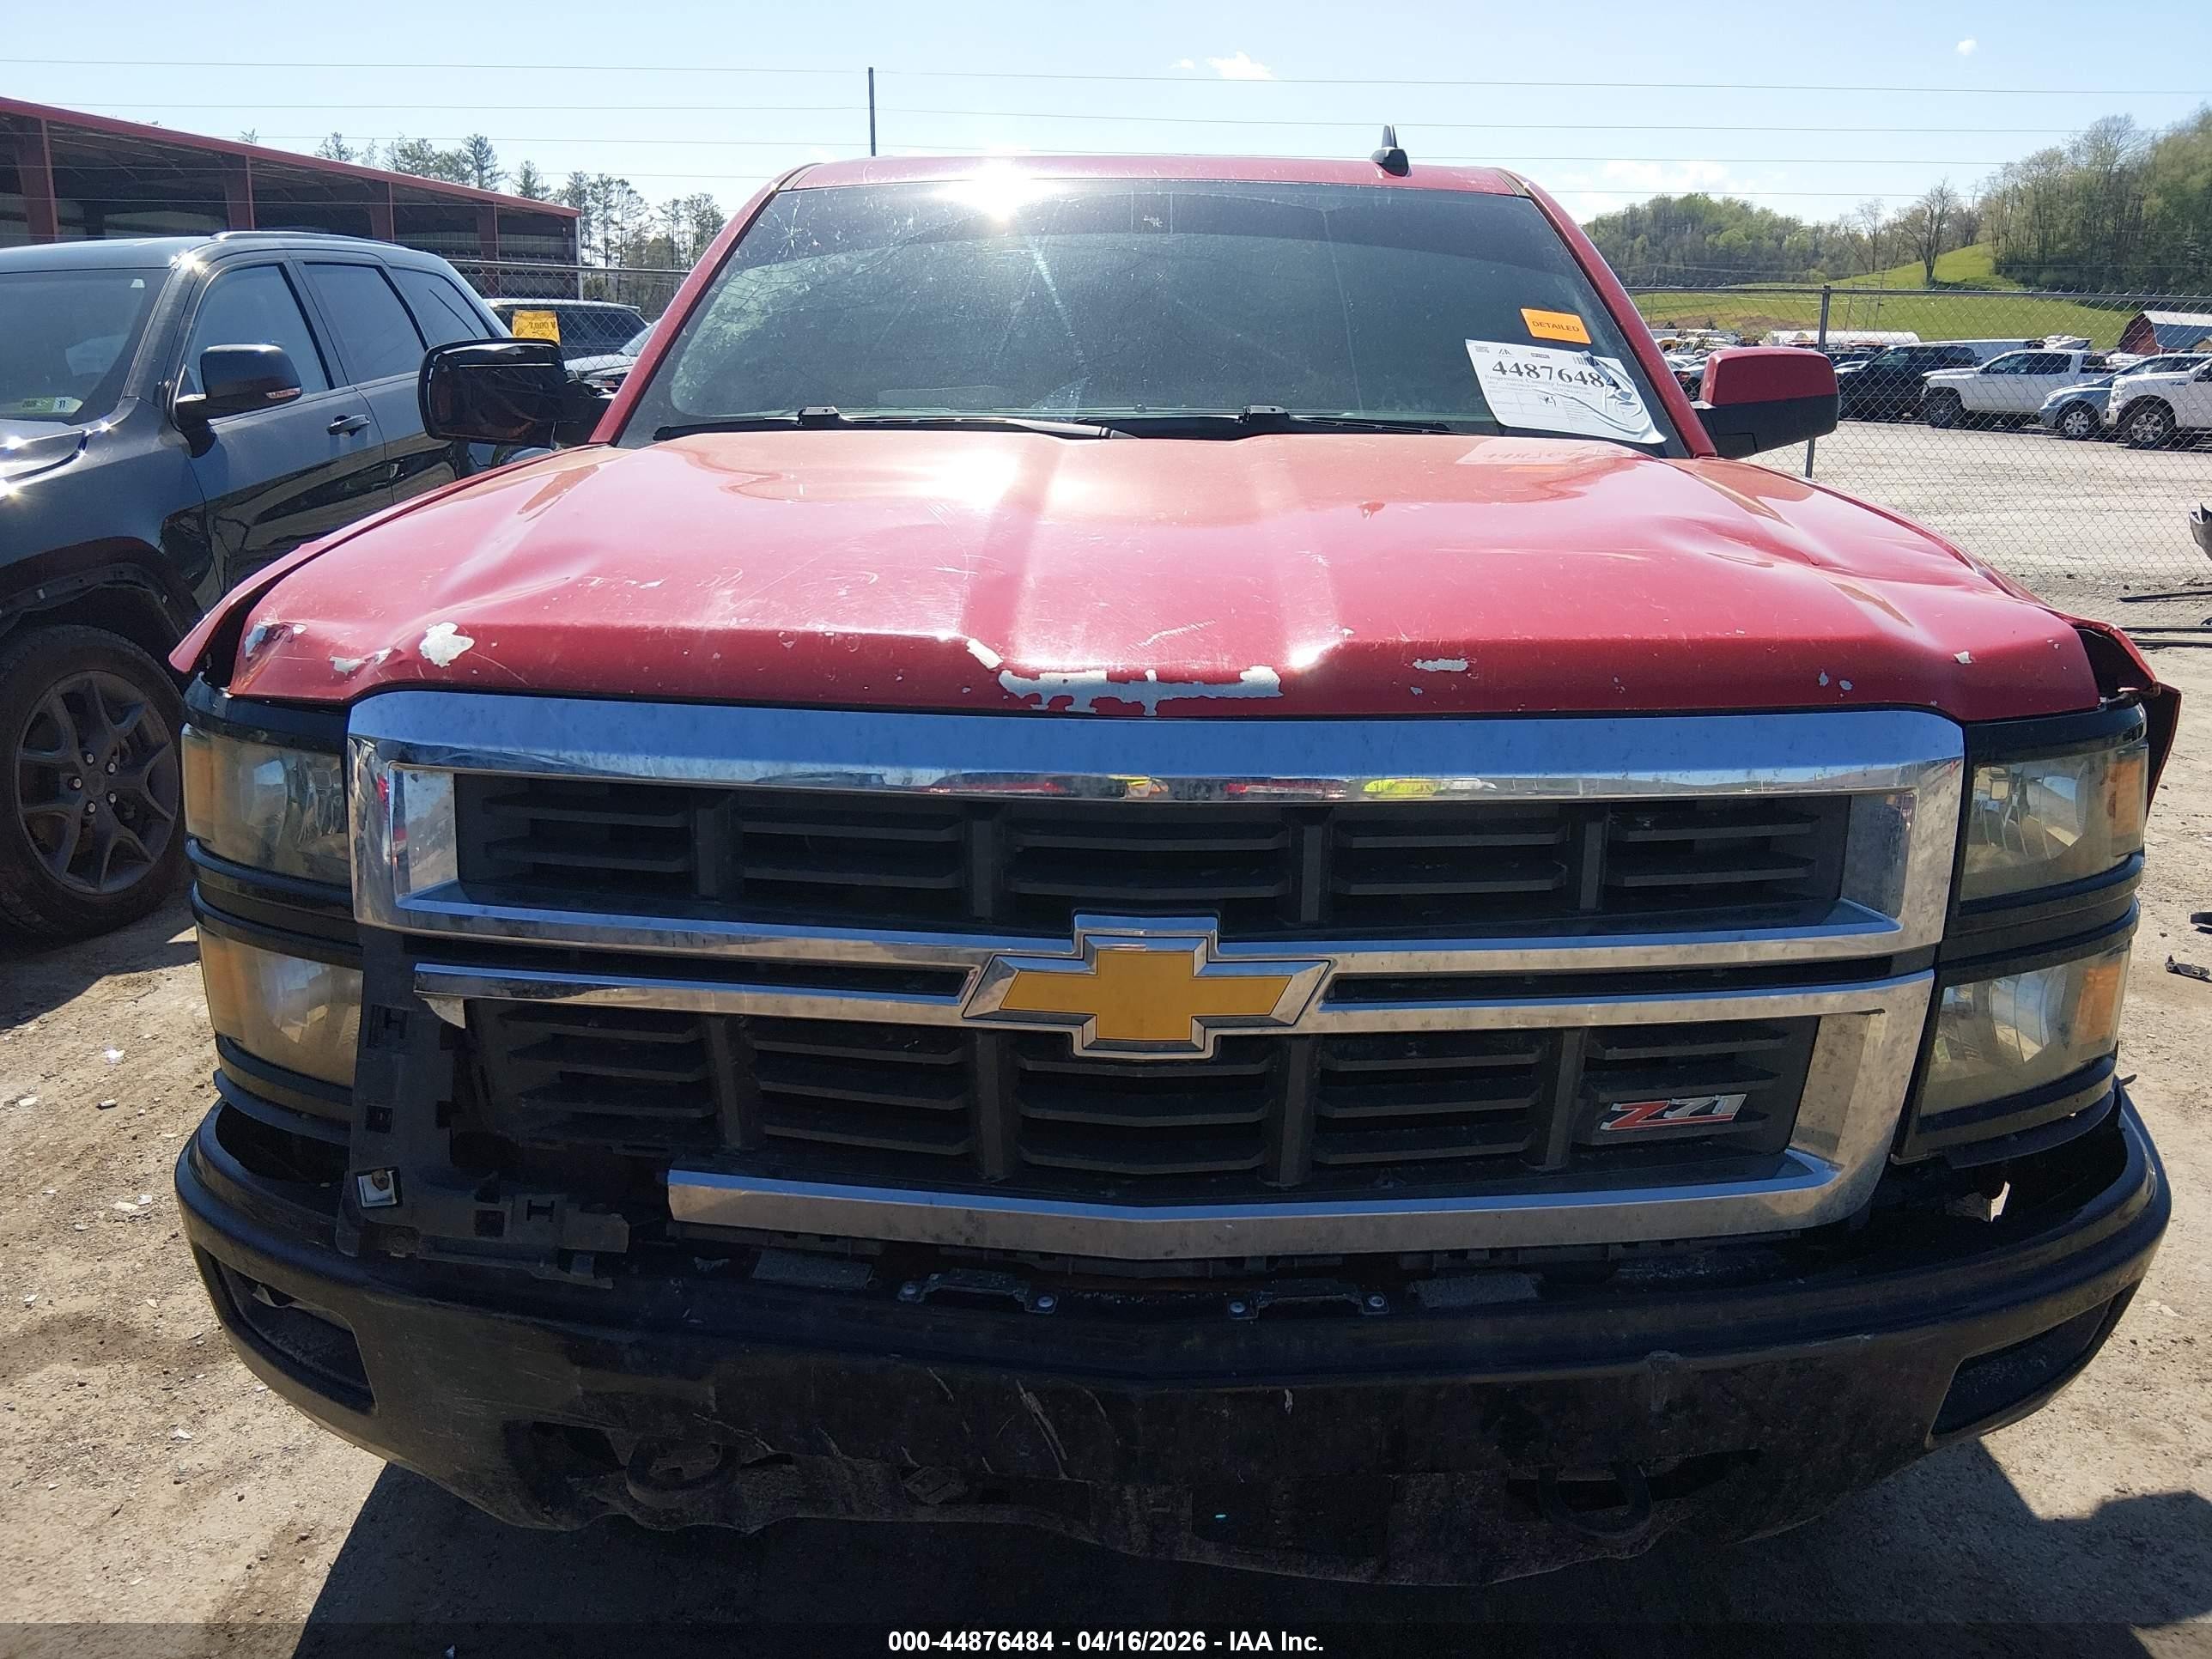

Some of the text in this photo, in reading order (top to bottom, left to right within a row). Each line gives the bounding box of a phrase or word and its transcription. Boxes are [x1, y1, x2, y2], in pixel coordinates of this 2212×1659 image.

[1532, 320, 1580, 332] DETAILED
[1492, 361, 1621, 390] 44876484
[1600, 1093, 1747, 1131] Z71
